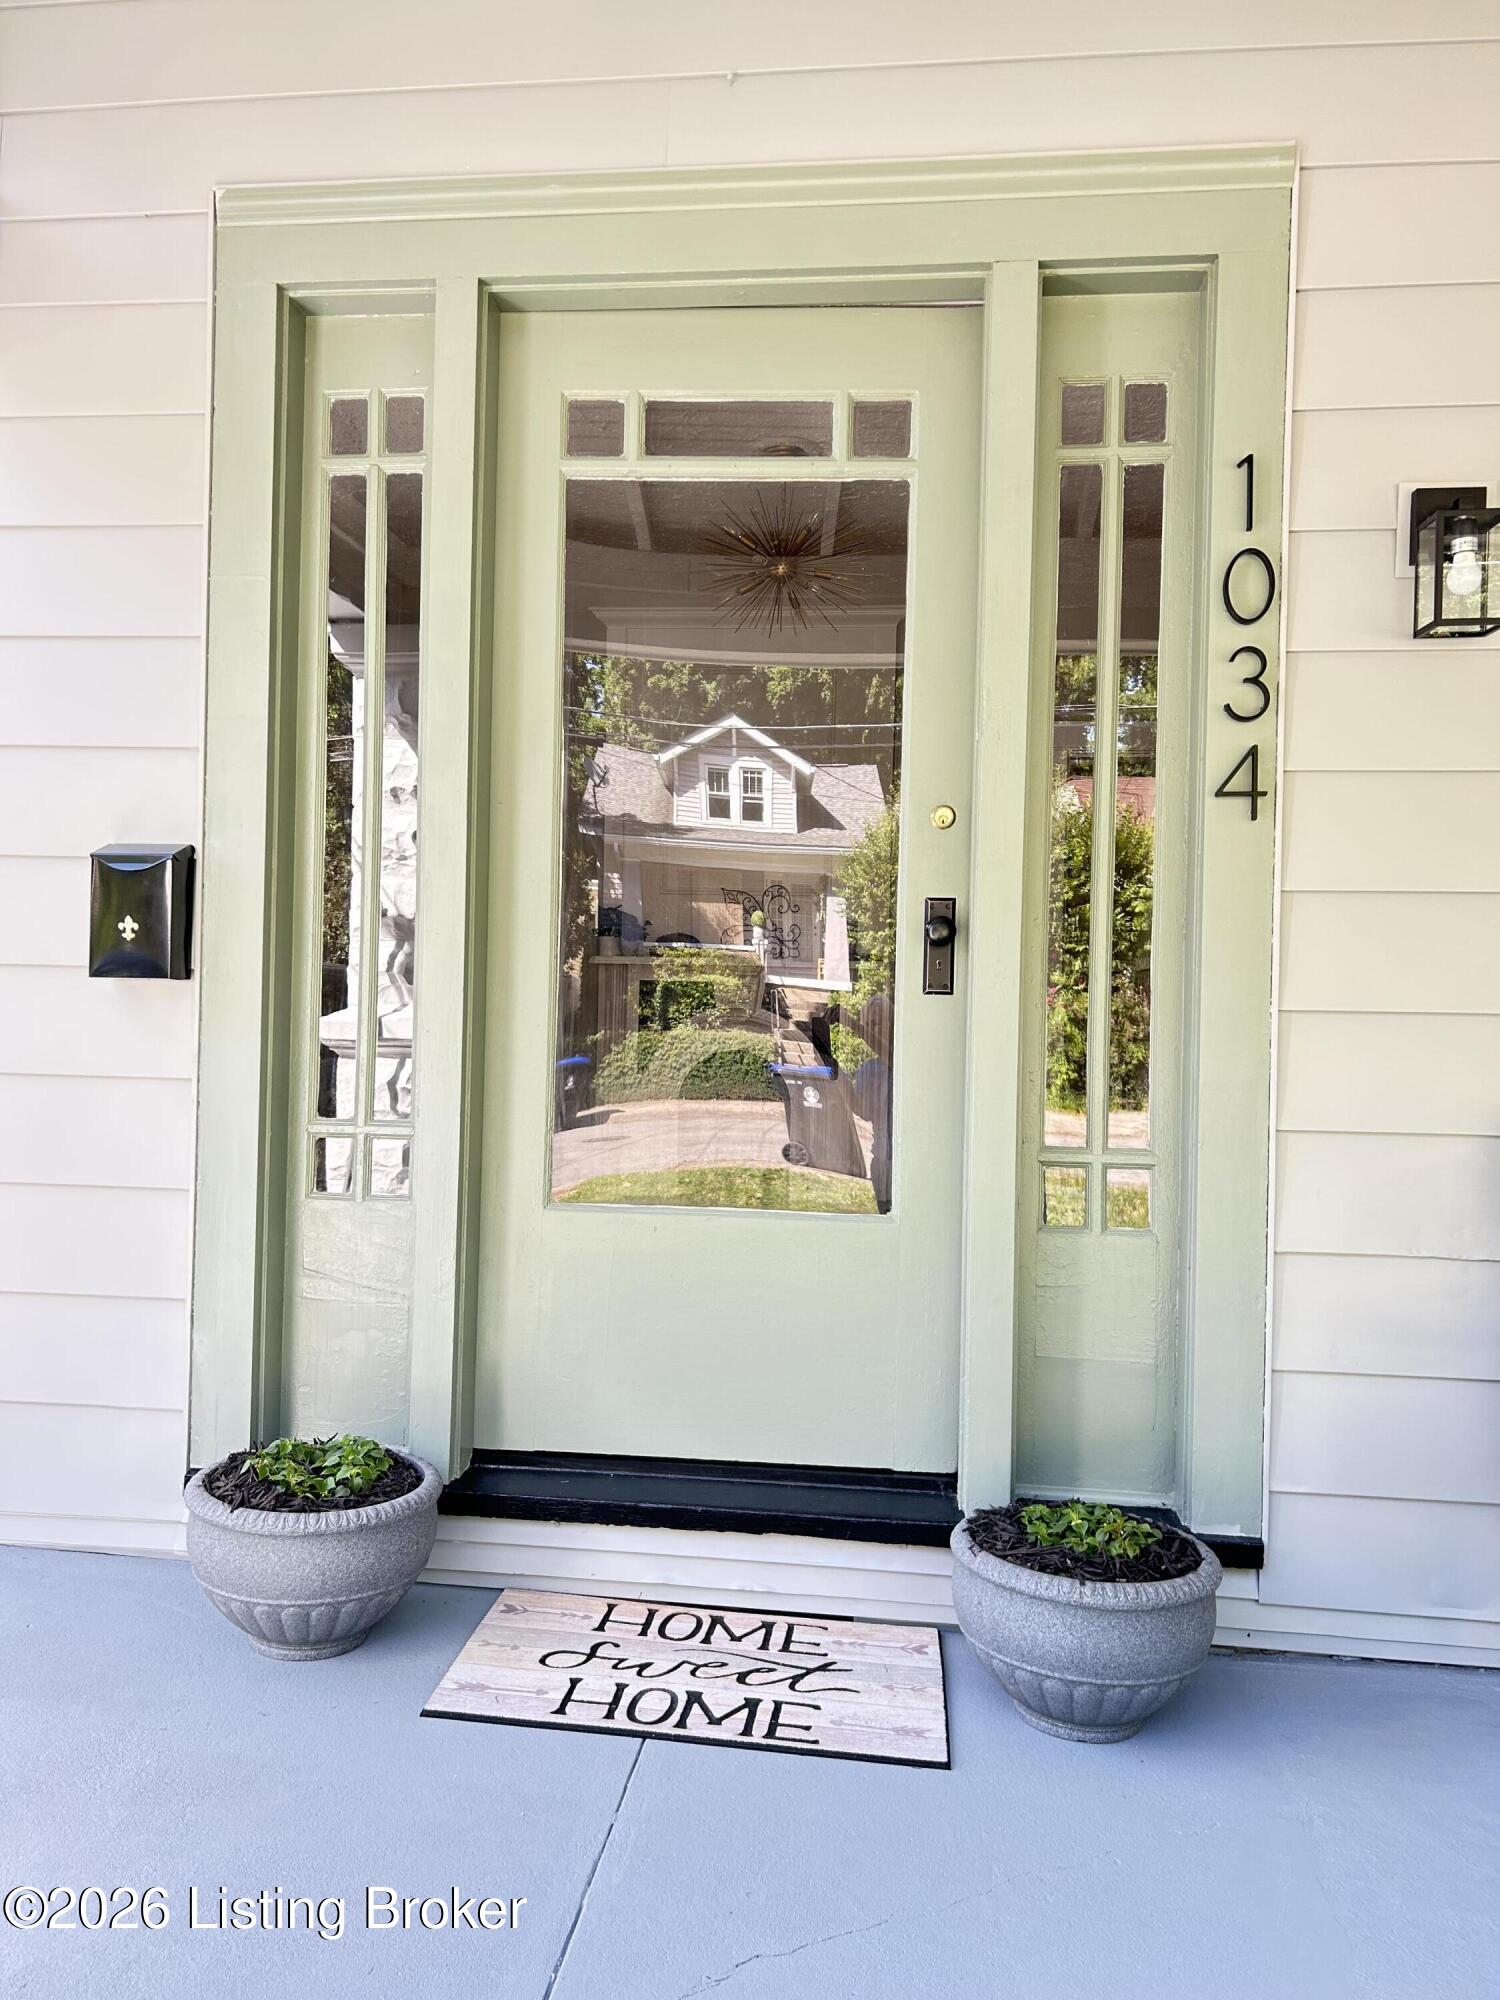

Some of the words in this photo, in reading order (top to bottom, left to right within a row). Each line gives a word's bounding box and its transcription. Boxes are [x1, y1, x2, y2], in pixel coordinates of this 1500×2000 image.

[1214, 453, 1276, 822] 1034
[592, 1603, 828, 1657] HOME
[550, 1678, 821, 1744] HOME
